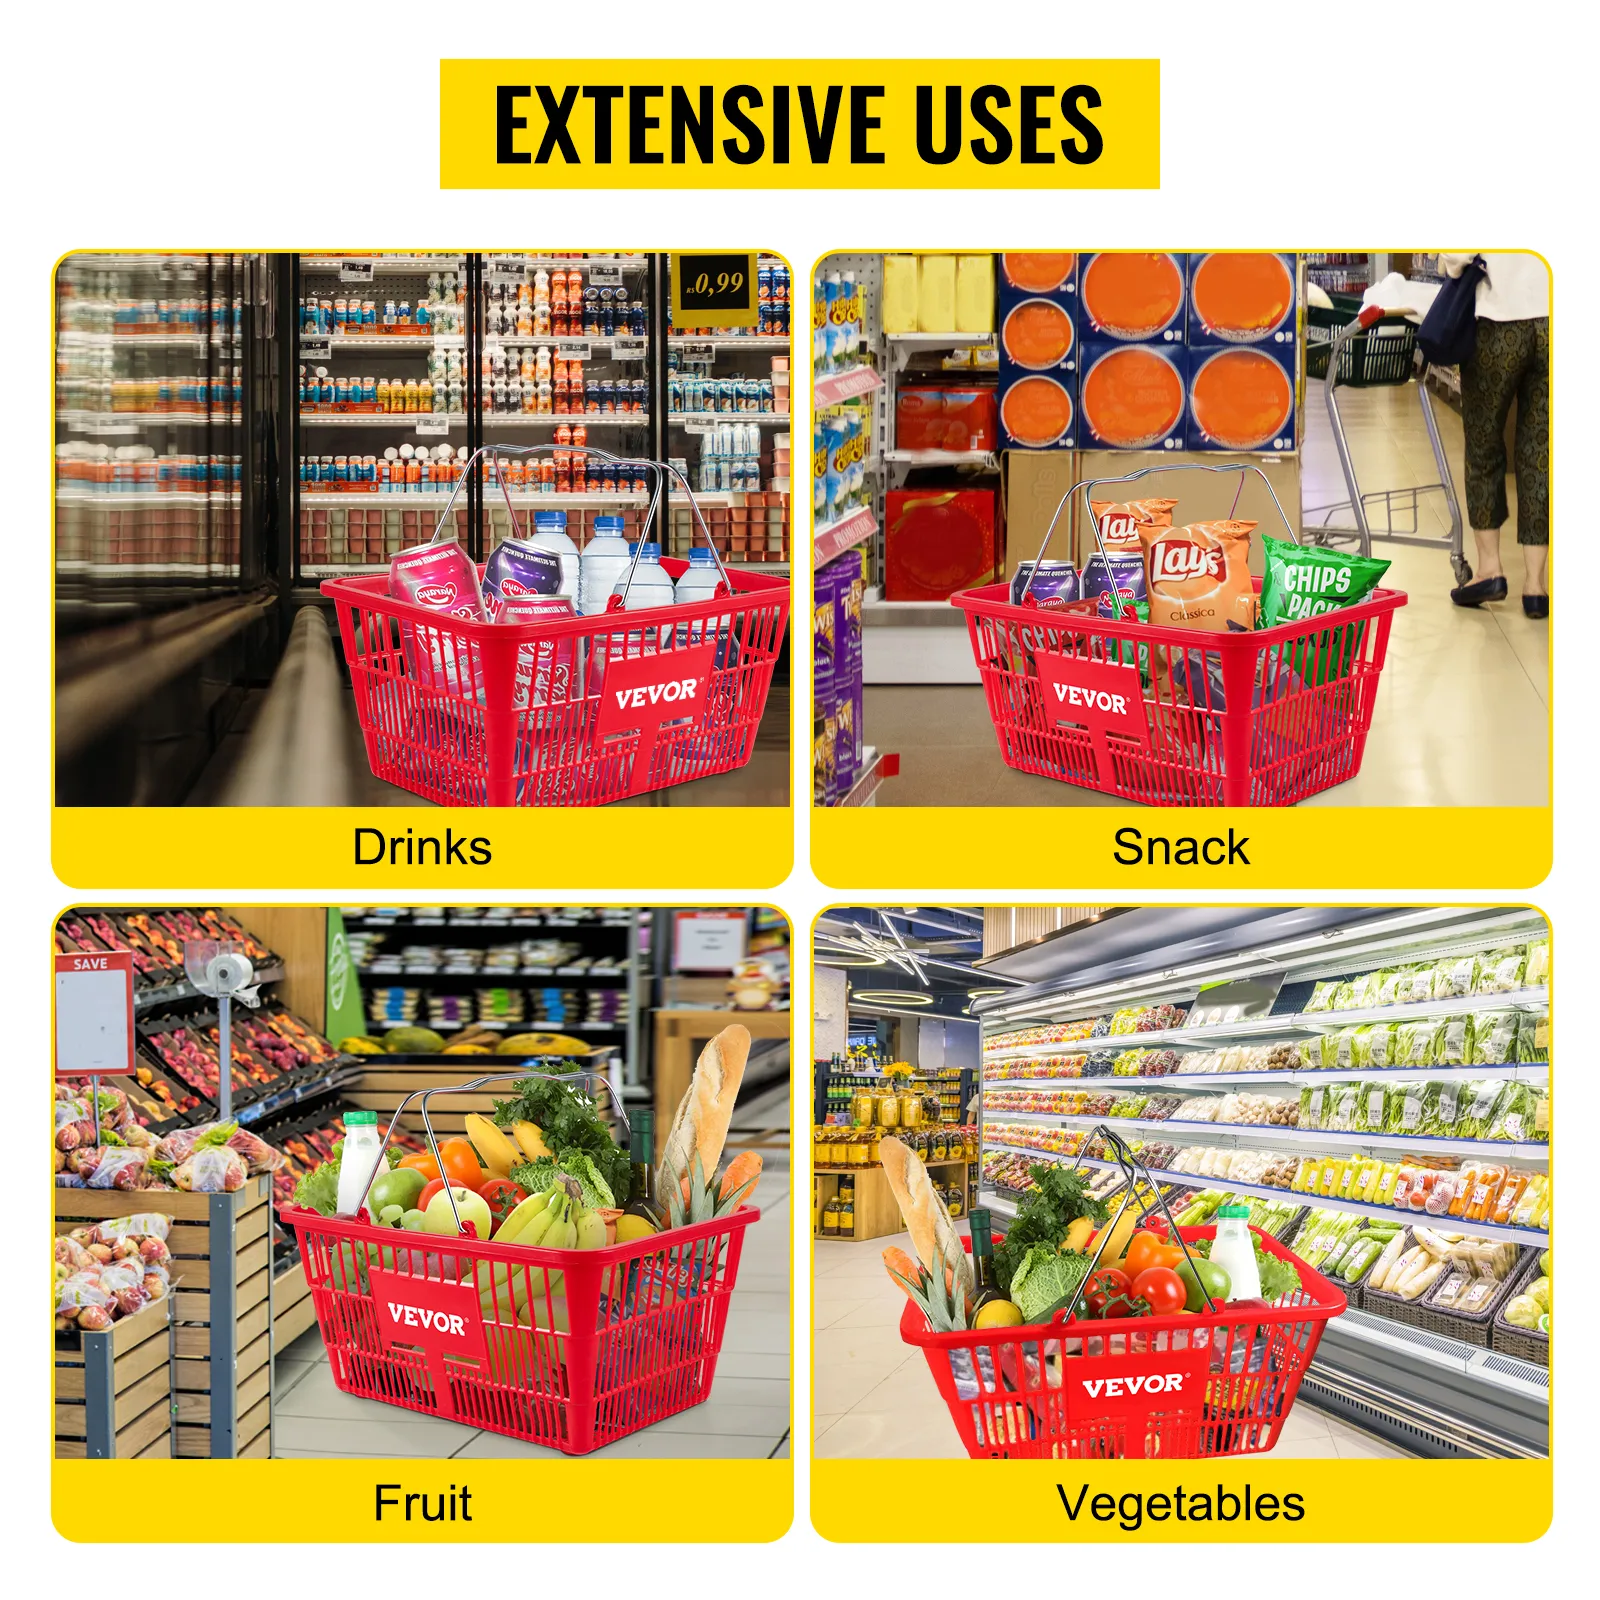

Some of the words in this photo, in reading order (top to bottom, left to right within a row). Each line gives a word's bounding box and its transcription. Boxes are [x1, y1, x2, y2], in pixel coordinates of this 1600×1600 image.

[833, 515, 872, 550] PROMOTION
[1102, 514, 1140, 544] Lay
[1151, 539, 1224, 583] Lay's
[1284, 565, 1352, 593] CHIPS
[1170, 606, 1216, 622] Classica
[73, 957, 108, 971] SAVE
